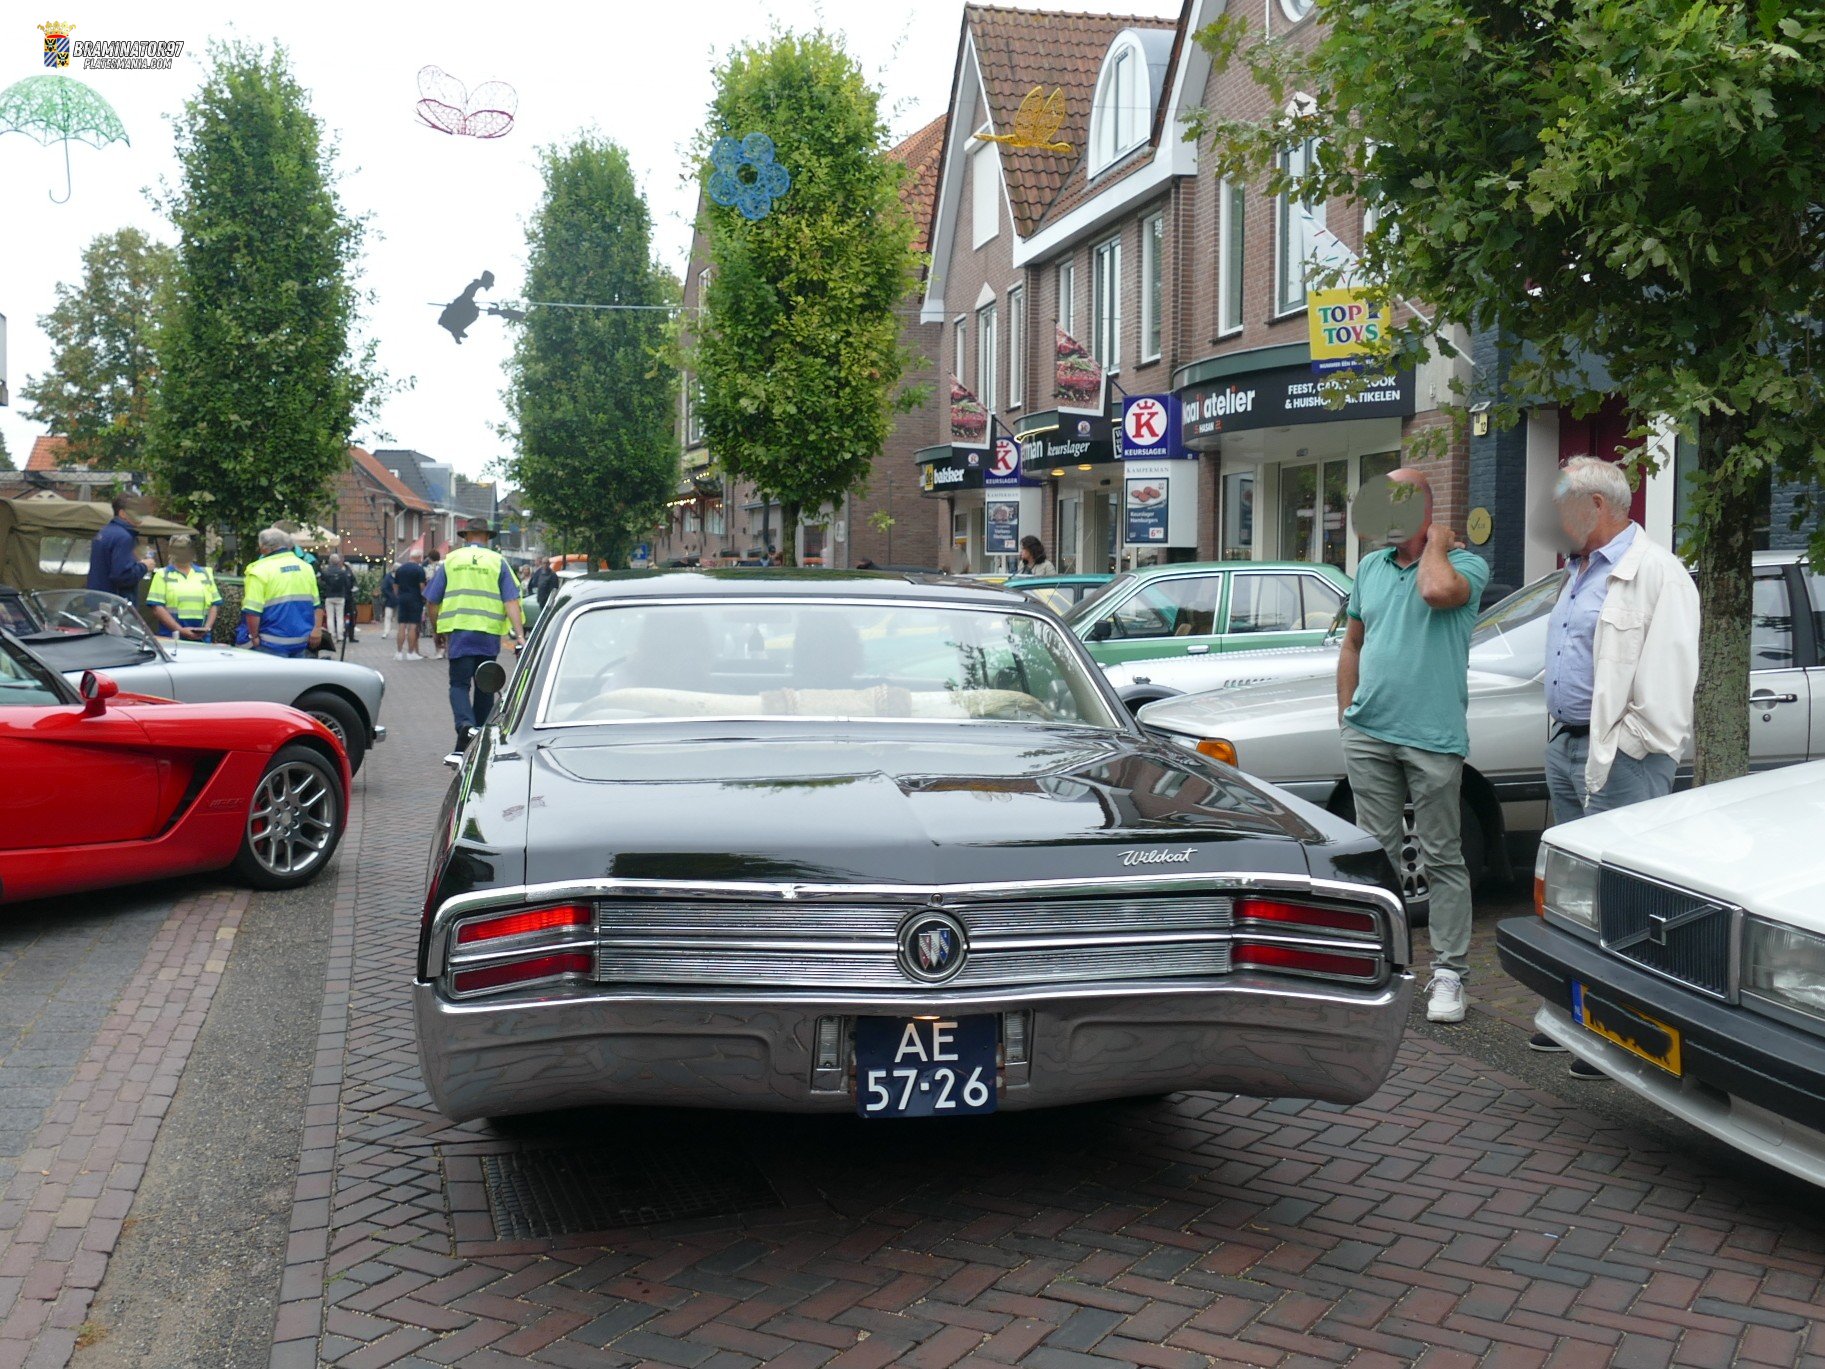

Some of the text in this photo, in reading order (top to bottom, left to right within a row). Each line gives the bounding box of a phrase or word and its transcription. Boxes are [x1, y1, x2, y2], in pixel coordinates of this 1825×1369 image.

[1318, 305, 1362, 323] TOP
[1323, 324, 1378, 344] TOYS
[1288, 382, 1316, 395] FEEST,
[1203, 386, 1256, 418] atelier
[1285, 399, 1292, 409] &
[1132, 411, 1160, 439] K
[1047, 440, 1091, 457] keurslager
[1124, 447, 1167, 456] KEURSLAGER
[991, 449, 1012, 471] K
[934, 466, 965, 485] bakker
[1126, 466, 1170, 474] KAMPERMAN
[986, 477, 1018, 485] KEURSLAGER
[1117, 847, 1199, 866] Wildcat
[894, 1021, 959, 1062] AE
